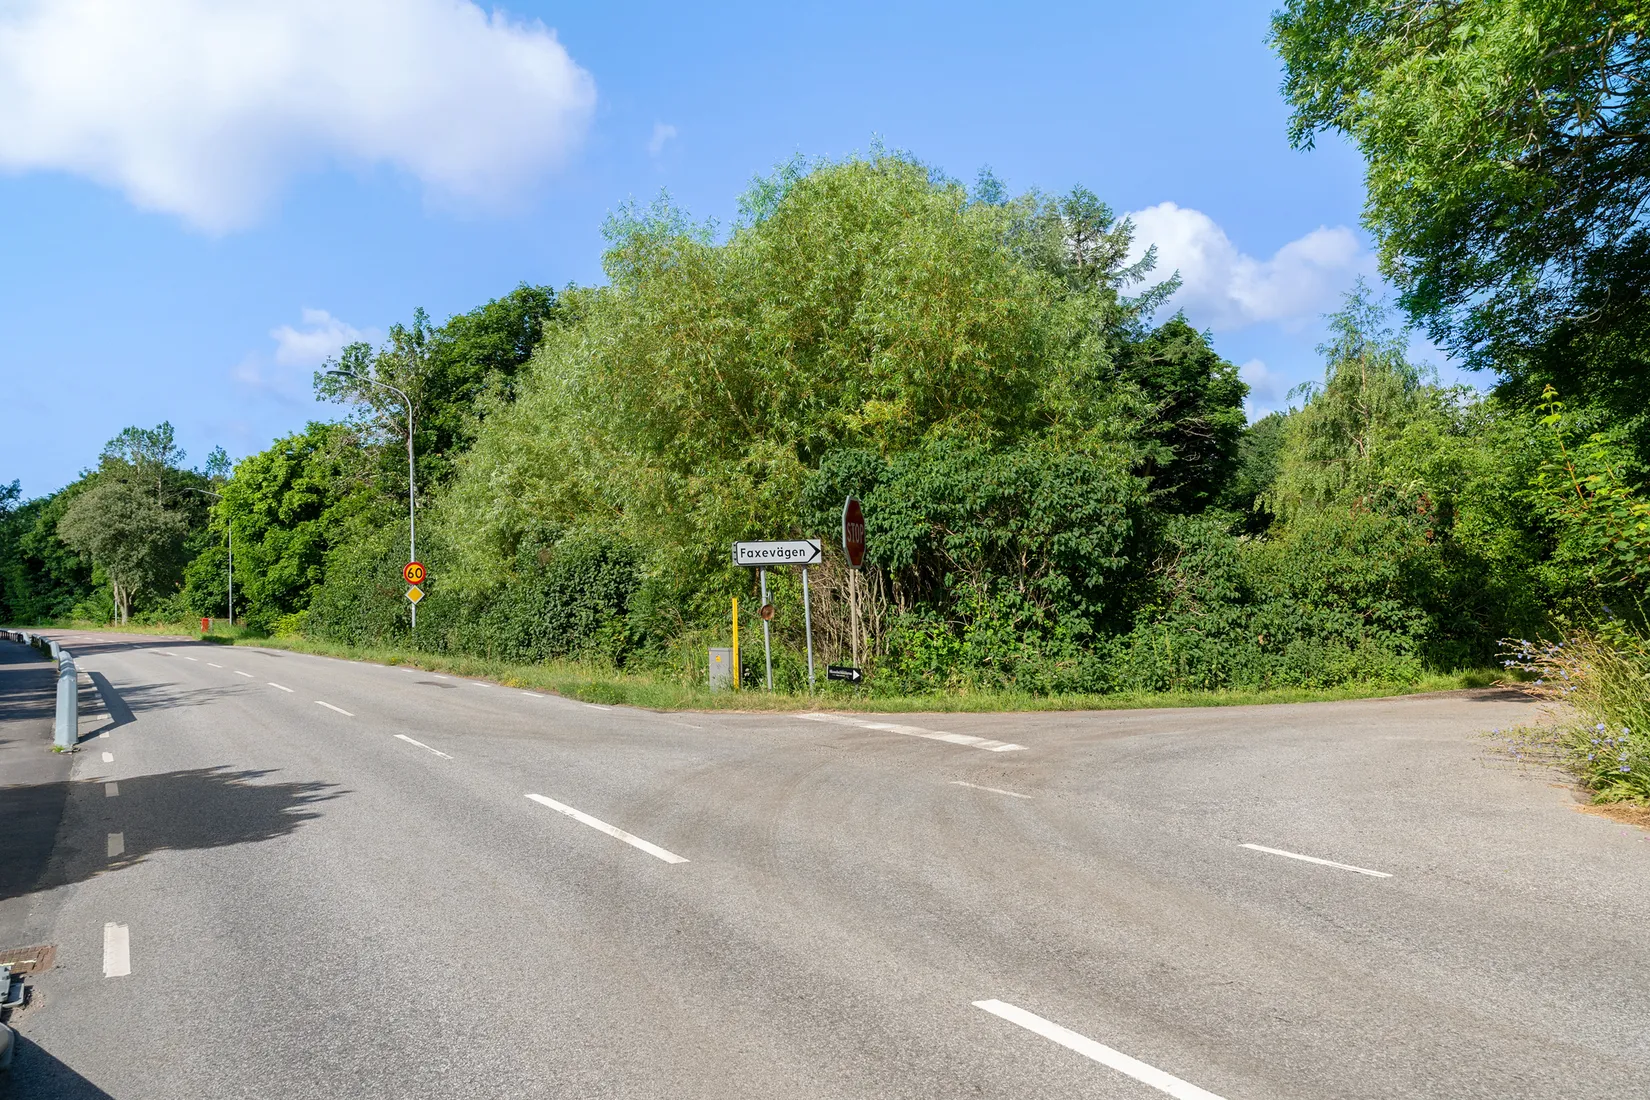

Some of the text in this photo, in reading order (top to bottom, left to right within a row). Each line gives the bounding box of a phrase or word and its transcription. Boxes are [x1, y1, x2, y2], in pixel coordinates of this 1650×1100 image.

[847, 522, 864, 544] STOP
[740, 547, 806, 559] Faxevägen
[408, 567, 423, 579] 60
